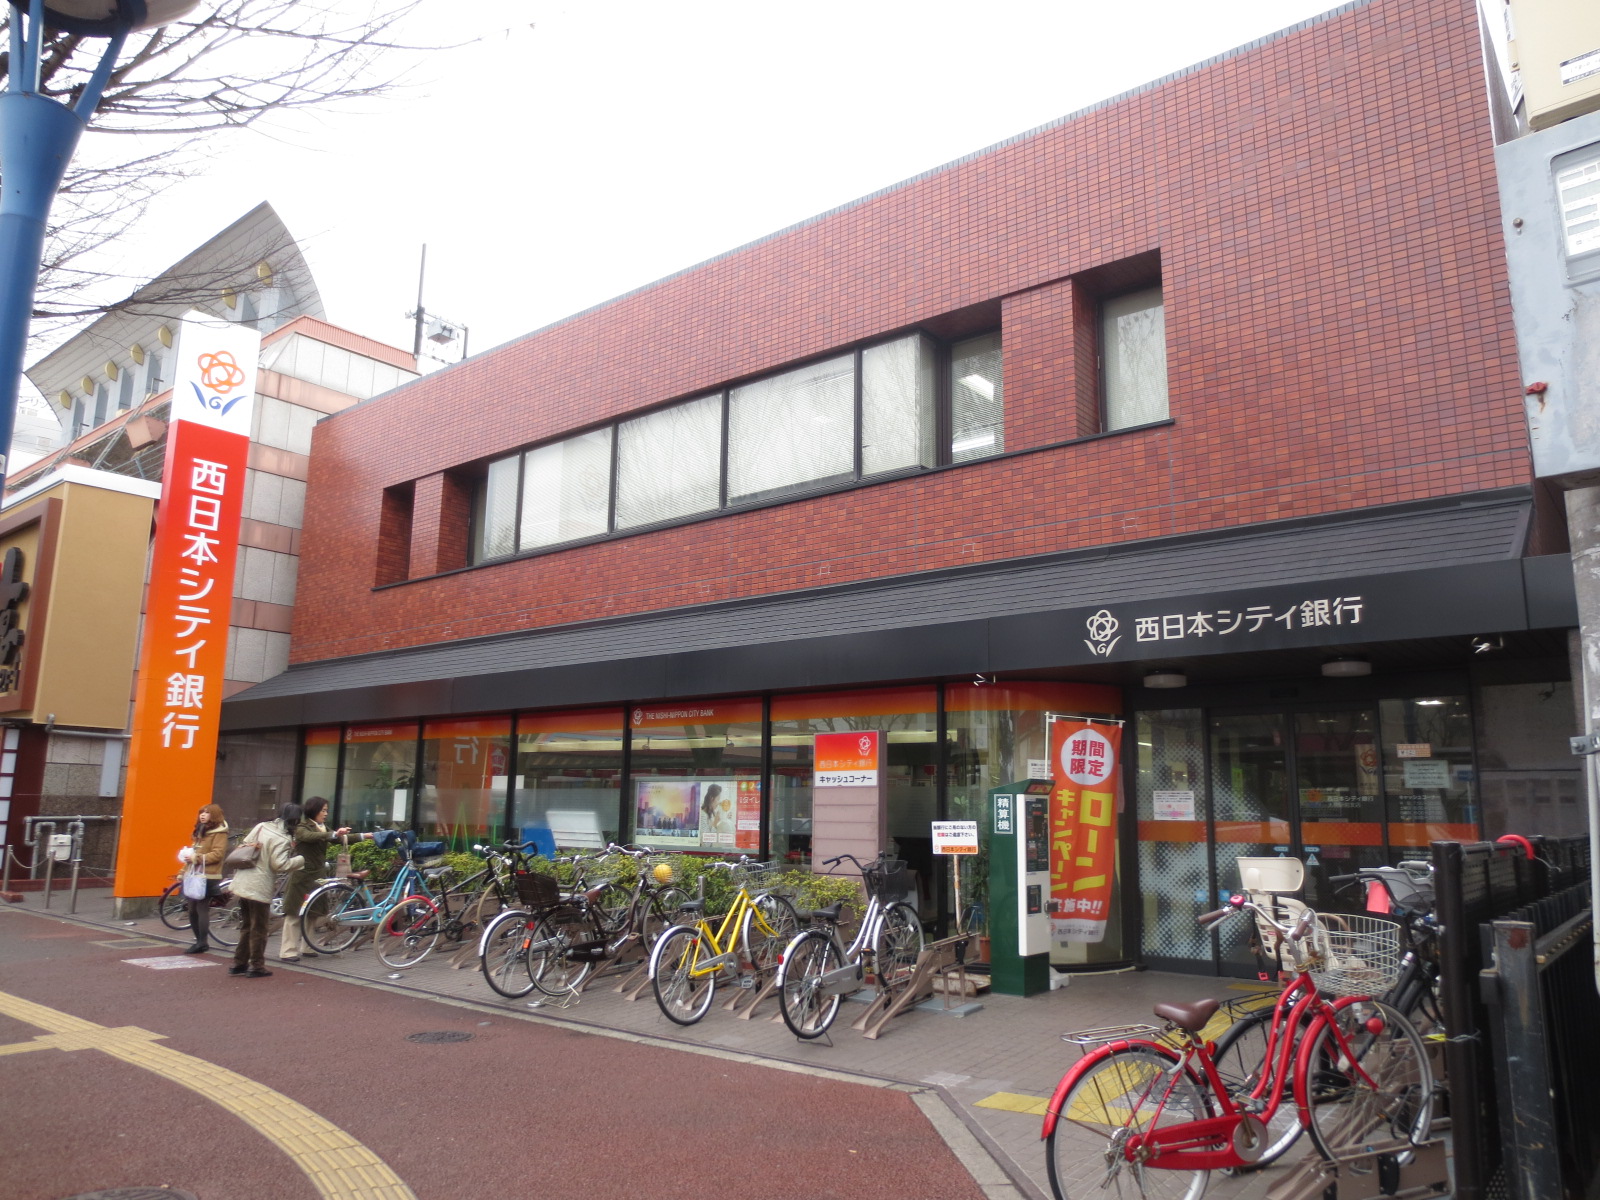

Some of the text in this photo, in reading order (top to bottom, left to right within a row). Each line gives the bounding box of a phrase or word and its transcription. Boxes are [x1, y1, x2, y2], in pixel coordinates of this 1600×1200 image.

[162, 457, 228, 749] 西日本シティ銀行
[1135, 596, 1363, 643] 西日本シティ銀行
[656, 711, 688, 719] NISHI-NIPPON
[1071, 739, 1105, 758] 期間
[819, 759, 872, 768] 西日本シティ銀行
[1070, 758, 1104, 777] 限定
[819, 775, 873, 784] キャッシュコーナー
[997, 797, 1010, 830] 精算機
[1050, 789, 1076, 892] キャンペーン
[1073, 790, 1113, 892] ローン
